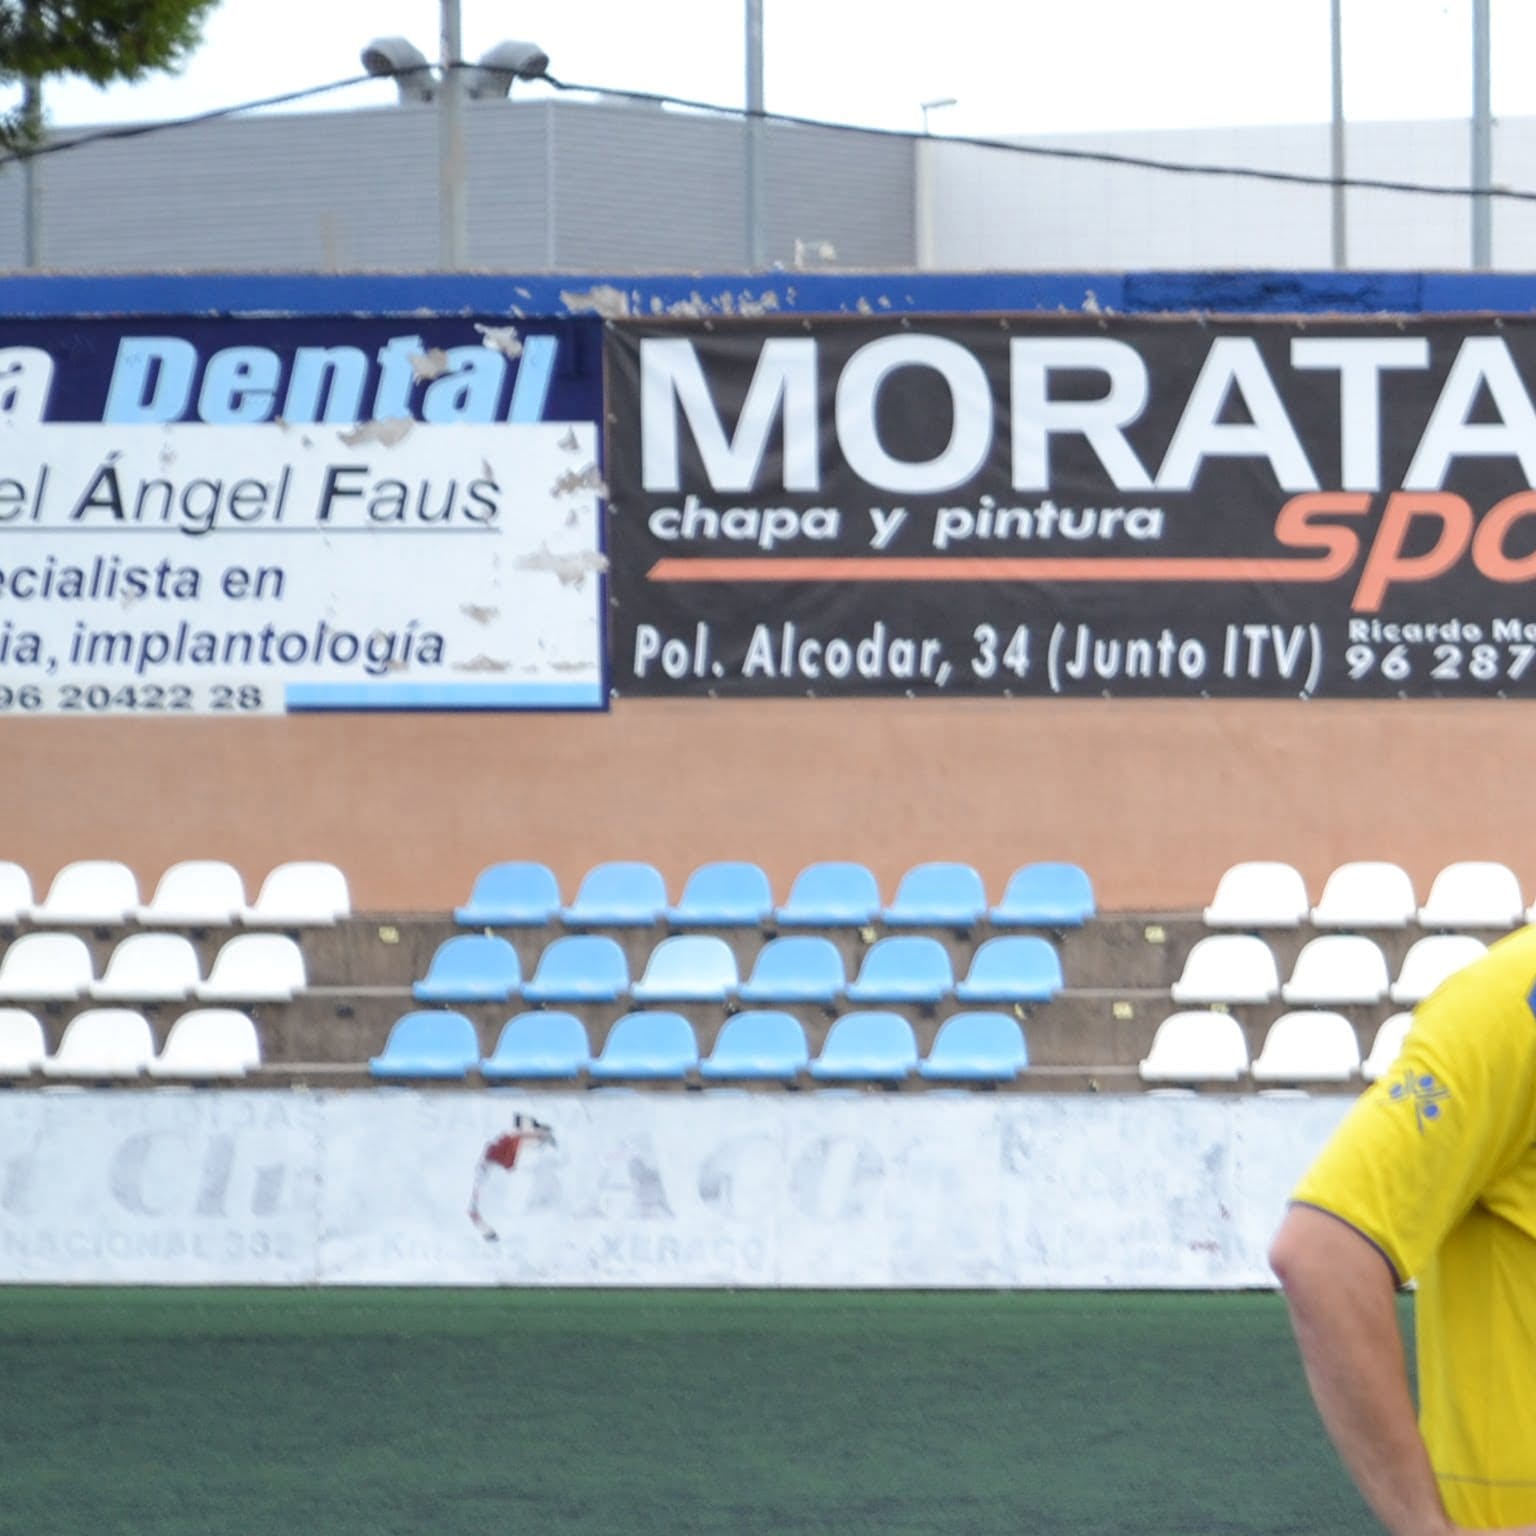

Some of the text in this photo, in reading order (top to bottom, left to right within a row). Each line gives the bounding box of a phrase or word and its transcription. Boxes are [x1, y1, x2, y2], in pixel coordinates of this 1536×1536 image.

[100, 335, 559, 424] Dental
[70, 450, 291, 536] Ángel
[317, 464, 500, 523] Faus
[648, 495, 1164, 549] chapa y pintura
[0, 555, 285, 599] cialista en
[69, 618, 446, 673] implantología
[1348, 618, 1483, 643] Ricardo
[633, 621, 1323, 697] Pol. Alcodar, 34 (Junto ITV)
[1345, 645, 1411, 681] 96
[1430, 645, 1536, 681] 287
[209, 684, 263, 711] 28
